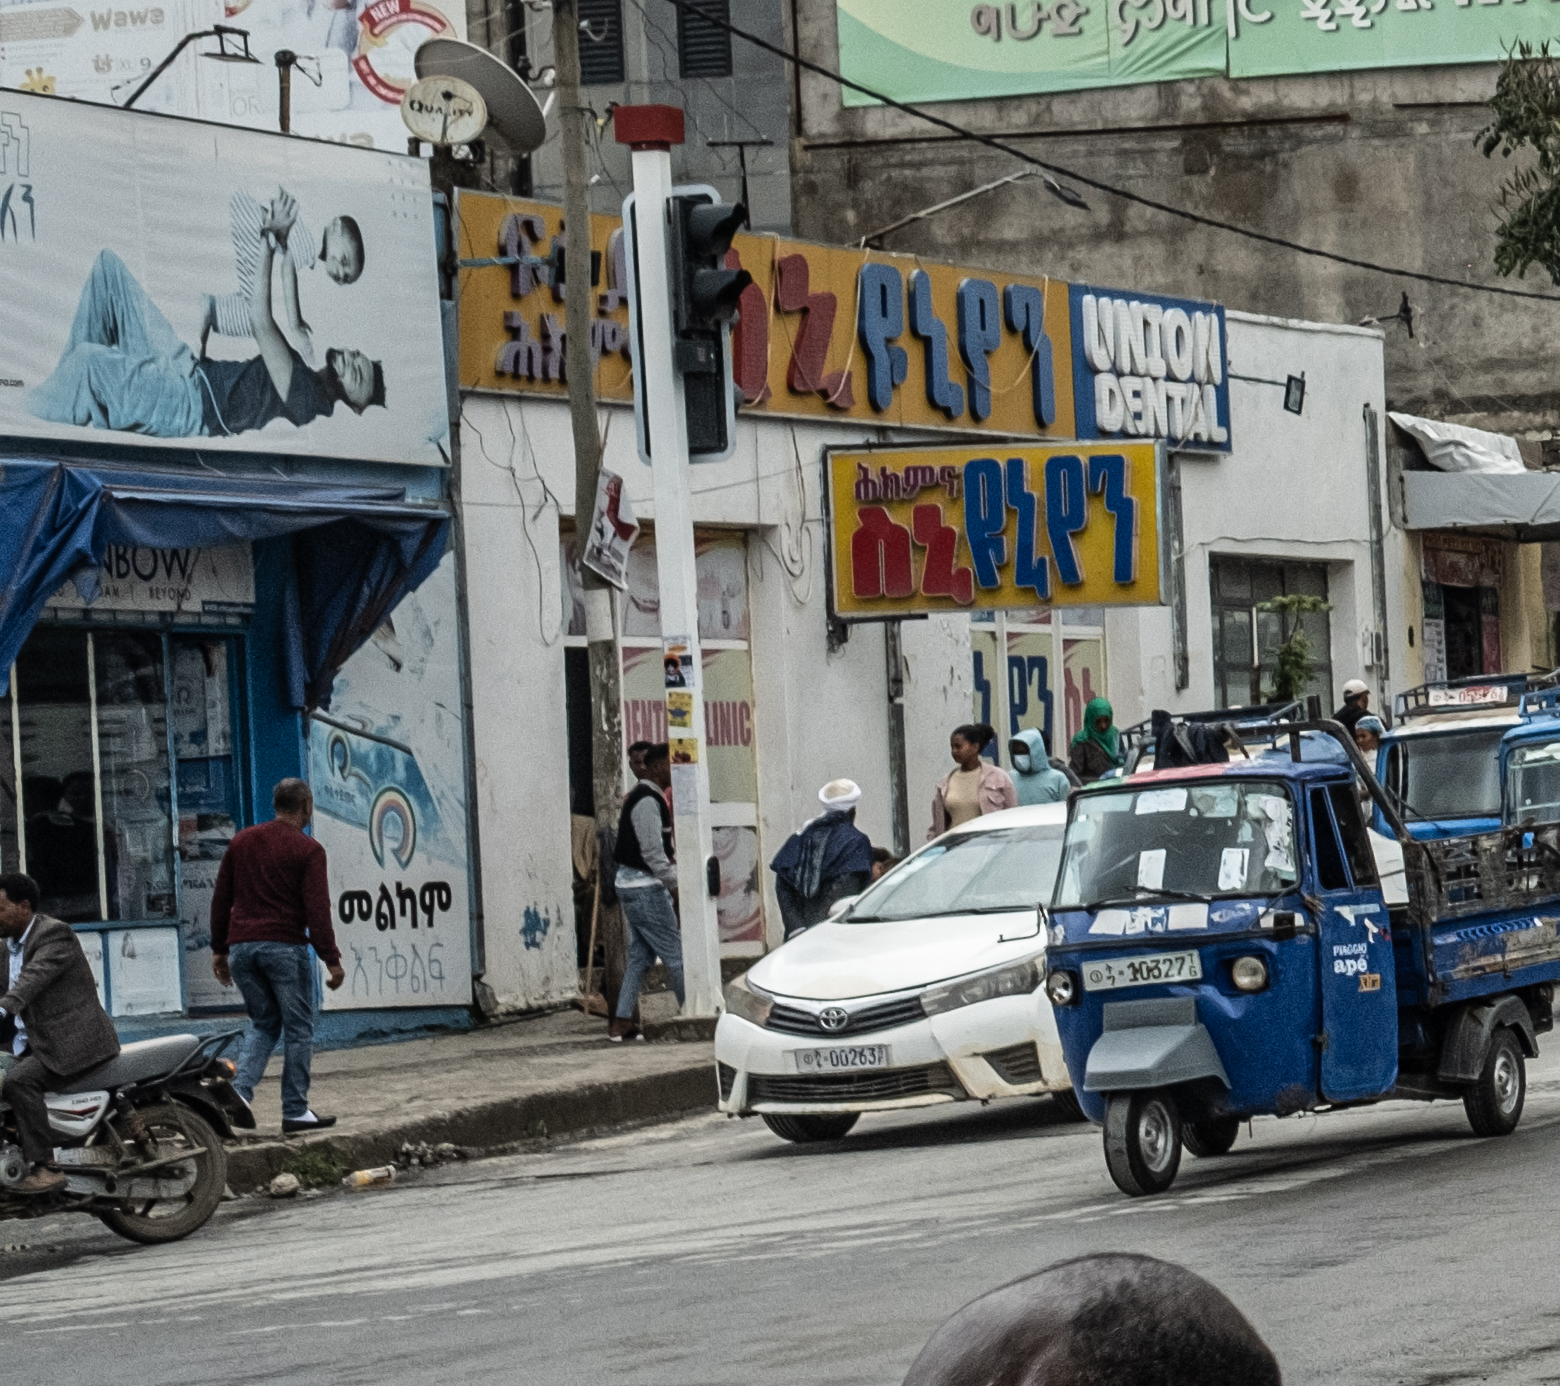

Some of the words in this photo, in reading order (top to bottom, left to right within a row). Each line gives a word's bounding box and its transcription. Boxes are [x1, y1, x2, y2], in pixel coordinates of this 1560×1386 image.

[90, 7, 165, 32] Wawa
[1081, 293, 1224, 386] UNION
[1093, 370, 1229, 444] DENTAL
[854, 463, 963, 503] ሕክምና
[338, 880, 452, 932] መልካም
[1127, 956, 1186, 983] 10327
[829, 1048, 876, 1068] 00263
